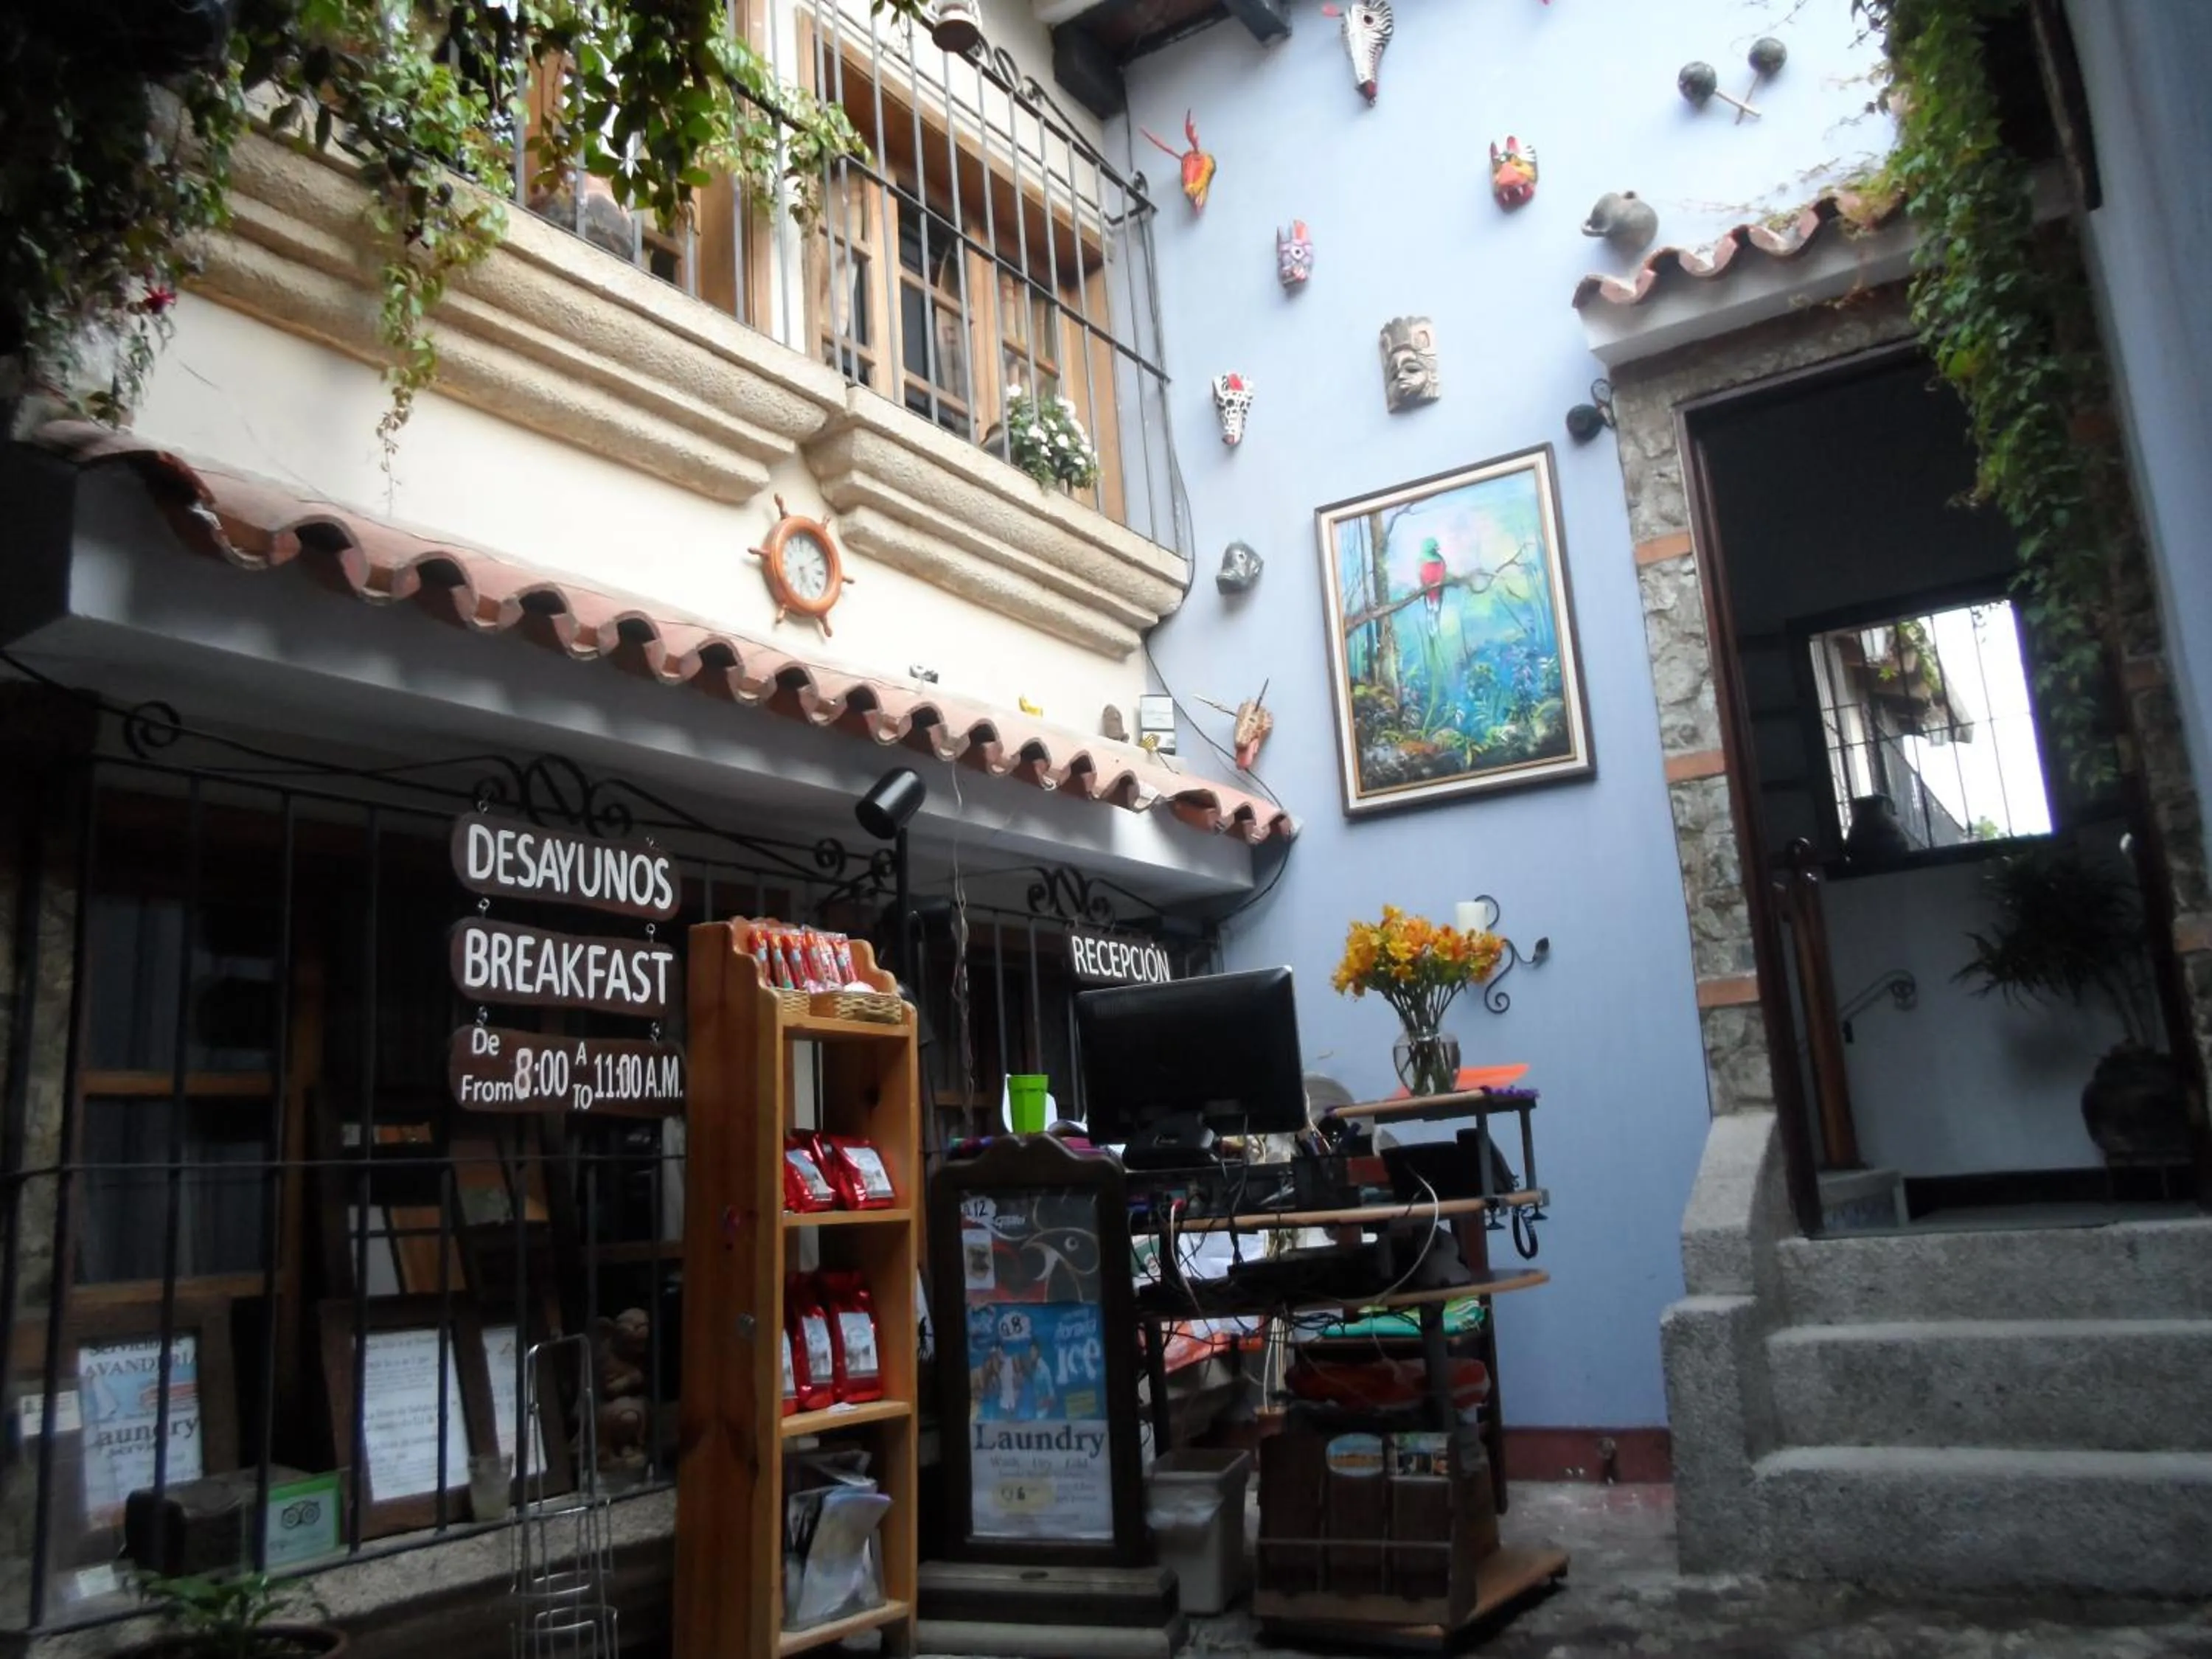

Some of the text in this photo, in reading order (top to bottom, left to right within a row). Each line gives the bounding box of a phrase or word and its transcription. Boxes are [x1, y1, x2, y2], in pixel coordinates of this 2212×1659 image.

[467, 824, 673, 910] DESAYUNOS
[464, 928, 673, 1004] BREAKFAST
[1071, 935, 1171, 982] RECEPCIÓN
[462, 1075, 513, 1102] From
[472, 1028, 500, 1055] De
[515, 1047, 568, 1099] 8:00
[575, 1041, 587, 1065] A
[594, 1054, 641, 1098] 11:00
[975, 1424, 1105, 1458] Laundry
